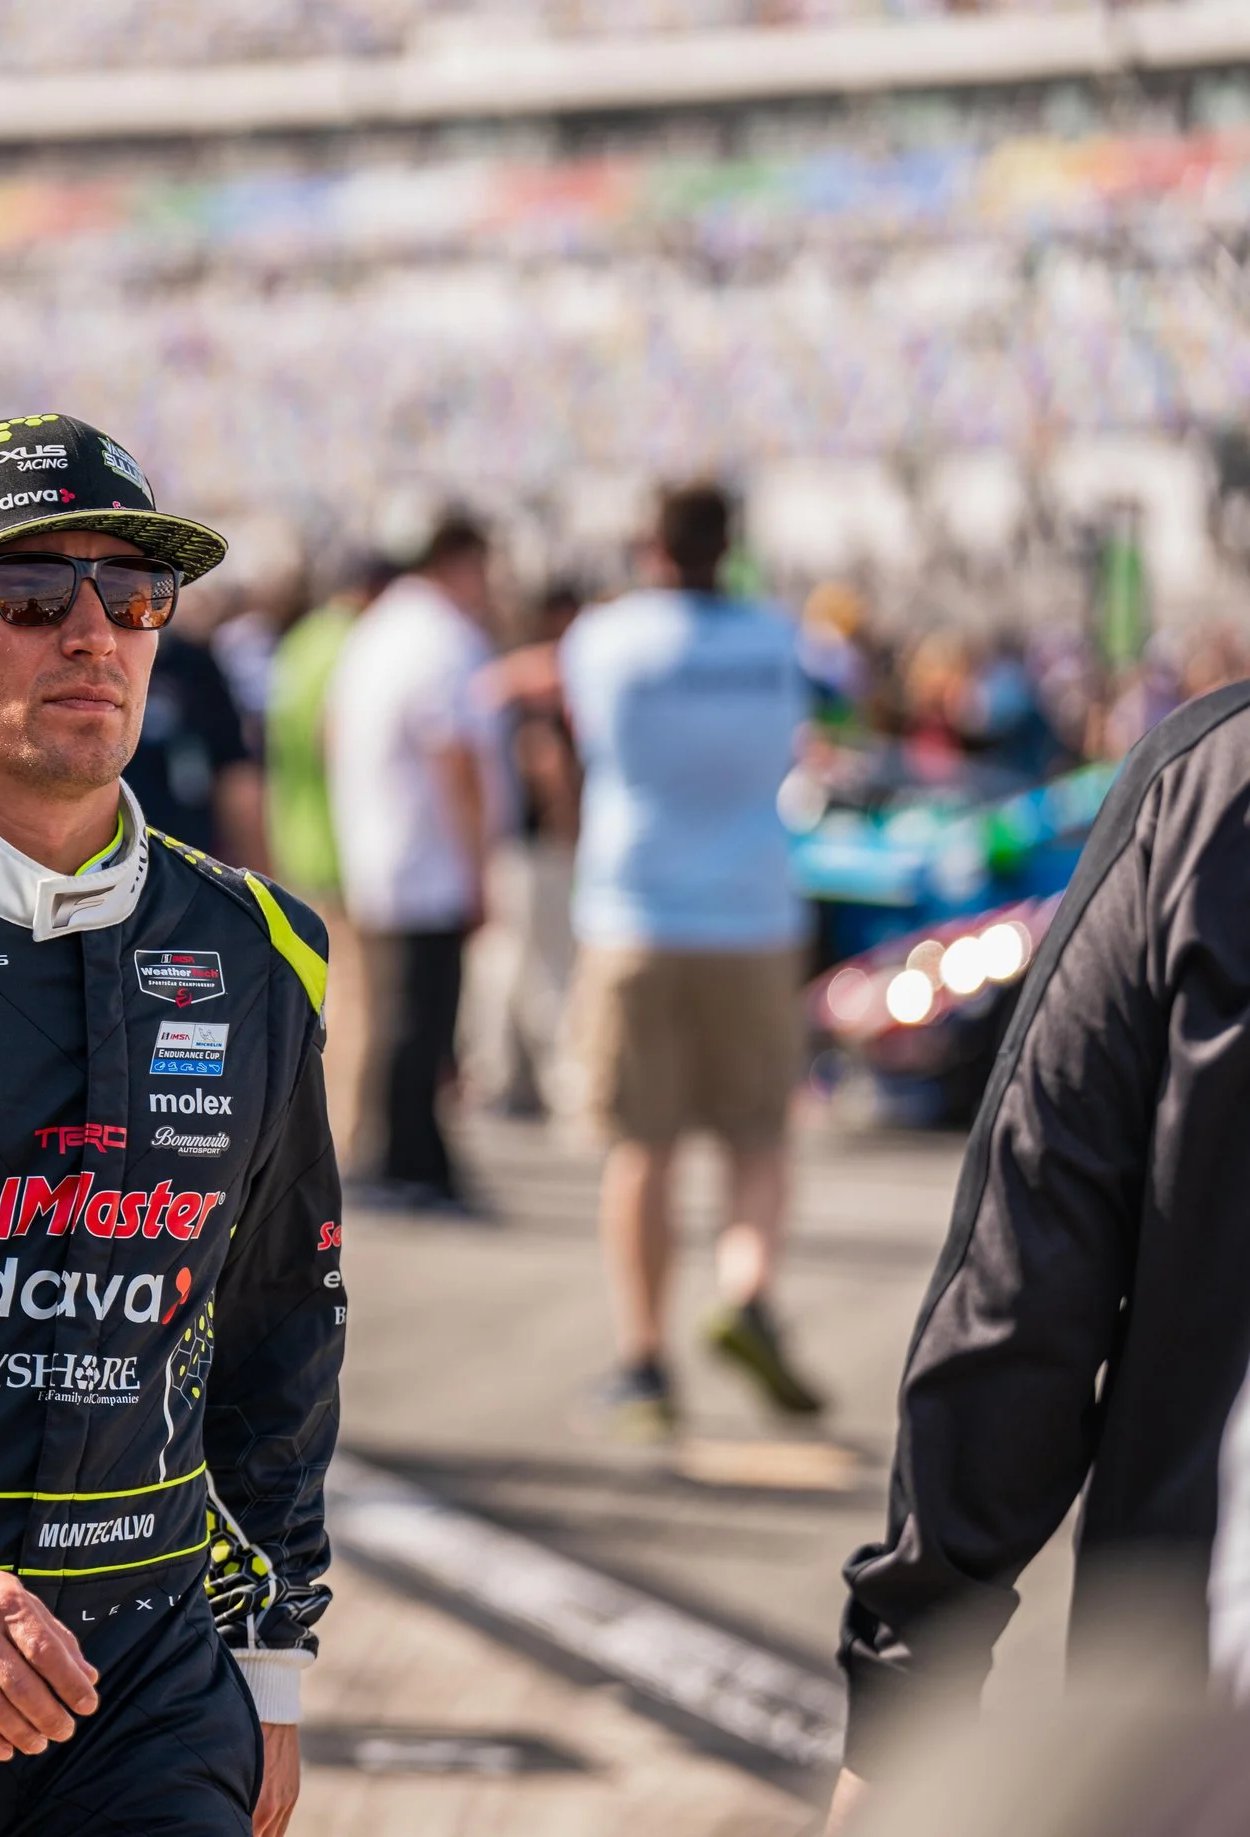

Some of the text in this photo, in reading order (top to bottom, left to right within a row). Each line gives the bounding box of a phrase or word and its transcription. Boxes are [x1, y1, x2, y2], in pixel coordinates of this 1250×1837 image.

[16, 458, 68, 472] RACING
[141, 967, 219, 978] WeatherTech
[158, 1049, 220, 1060] ENDURANCE CUP
[150, 1088, 232, 1115] molex
[152, 1126, 230, 1149] Bommarito
[91, 1393, 140, 1406] Companies
[38, 1513, 155, 1548] MONTECALVO
